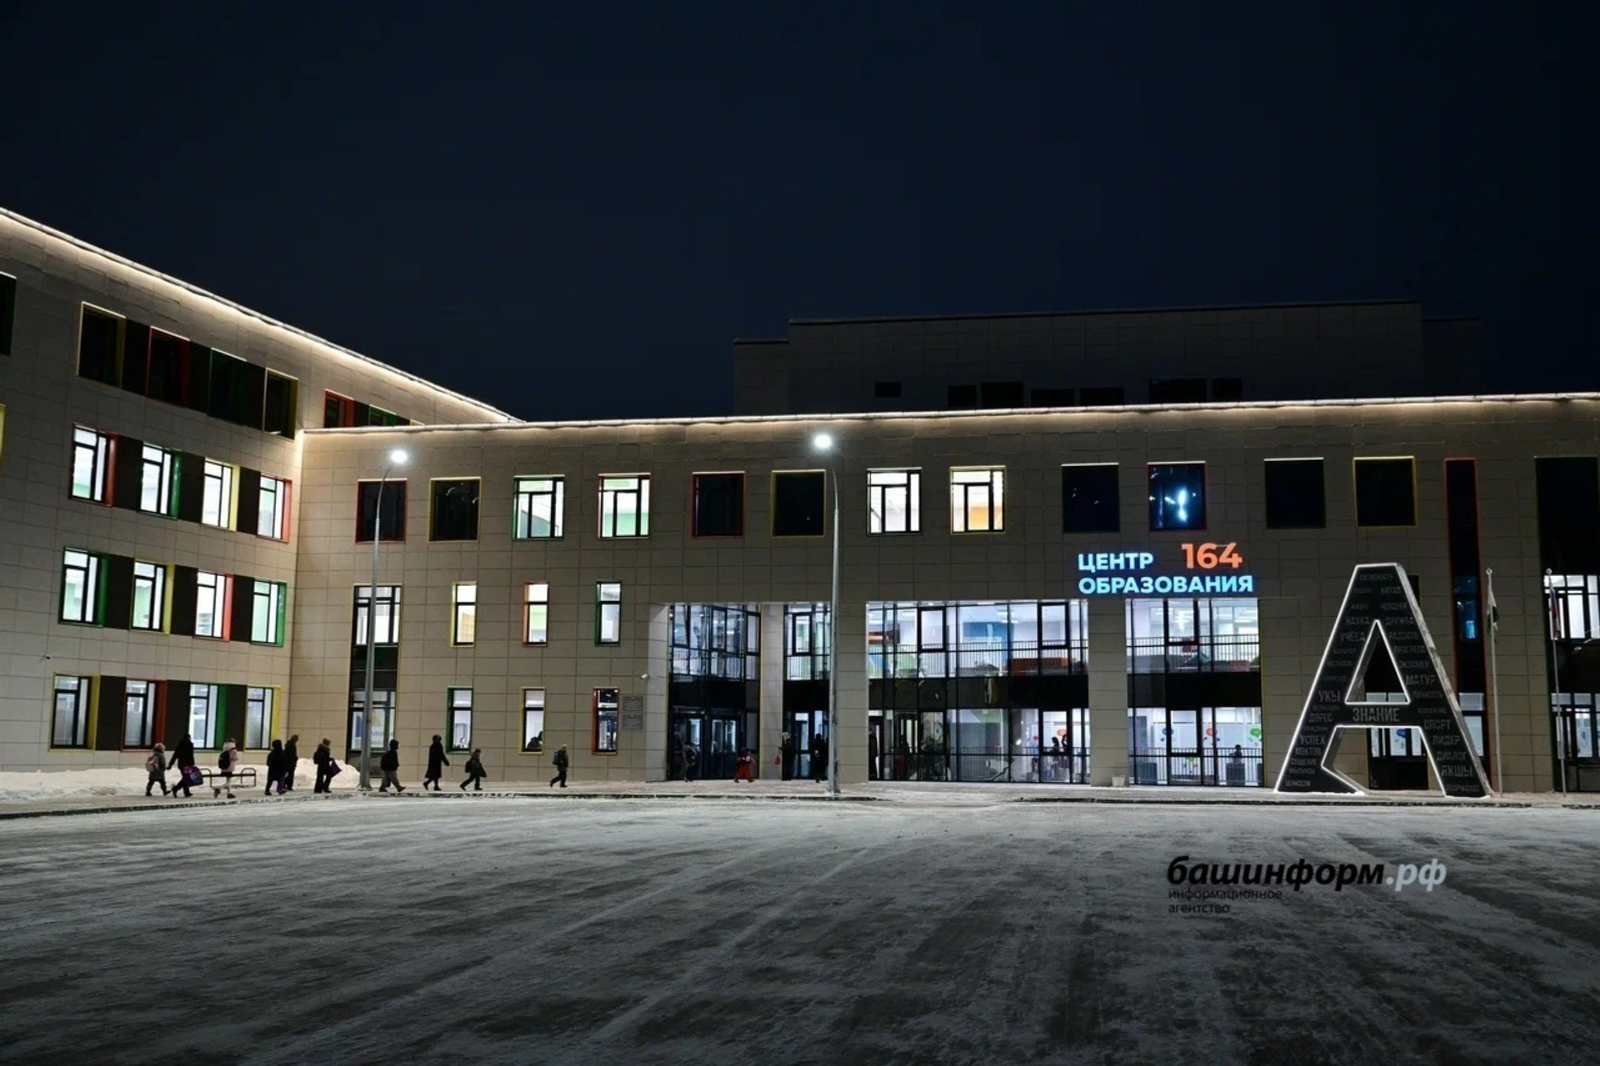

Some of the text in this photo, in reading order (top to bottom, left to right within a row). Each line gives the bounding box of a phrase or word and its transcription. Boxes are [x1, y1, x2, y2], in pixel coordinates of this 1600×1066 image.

[1078, 553, 1154, 573] ЦЕНТР
[1181, 542, 1243, 569] 164
[1078, 575, 1253, 594] ОБРАЗОВАНИЯ
[1352, 707, 1400, 722] ЗНАНИЕ
[1424, 719, 1452, 730] СПОРТ
[1299, 734, 1326, 745] УСПЕХ
[1432, 735, 1460, 746] ЛИДЕР
